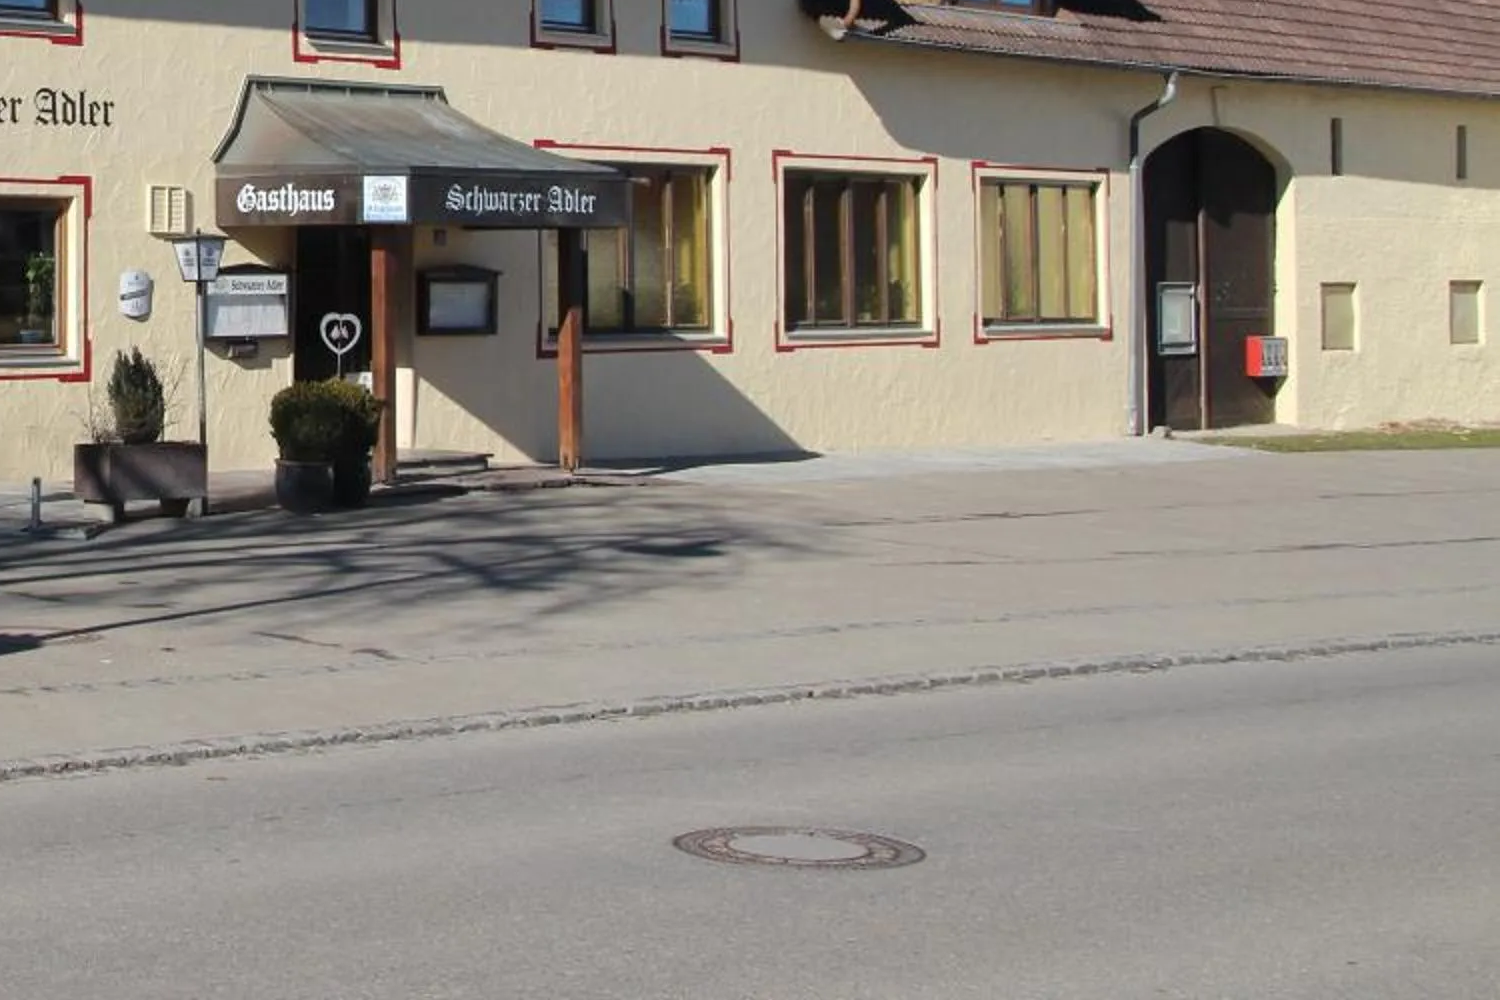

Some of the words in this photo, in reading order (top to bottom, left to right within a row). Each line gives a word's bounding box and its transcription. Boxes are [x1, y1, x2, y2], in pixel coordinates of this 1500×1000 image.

[34, 87, 115, 127] Adler
[236, 183, 336, 217] Gasthaus
[445, 183, 542, 217] Schwarzer
[547, 184, 597, 215] Adler
